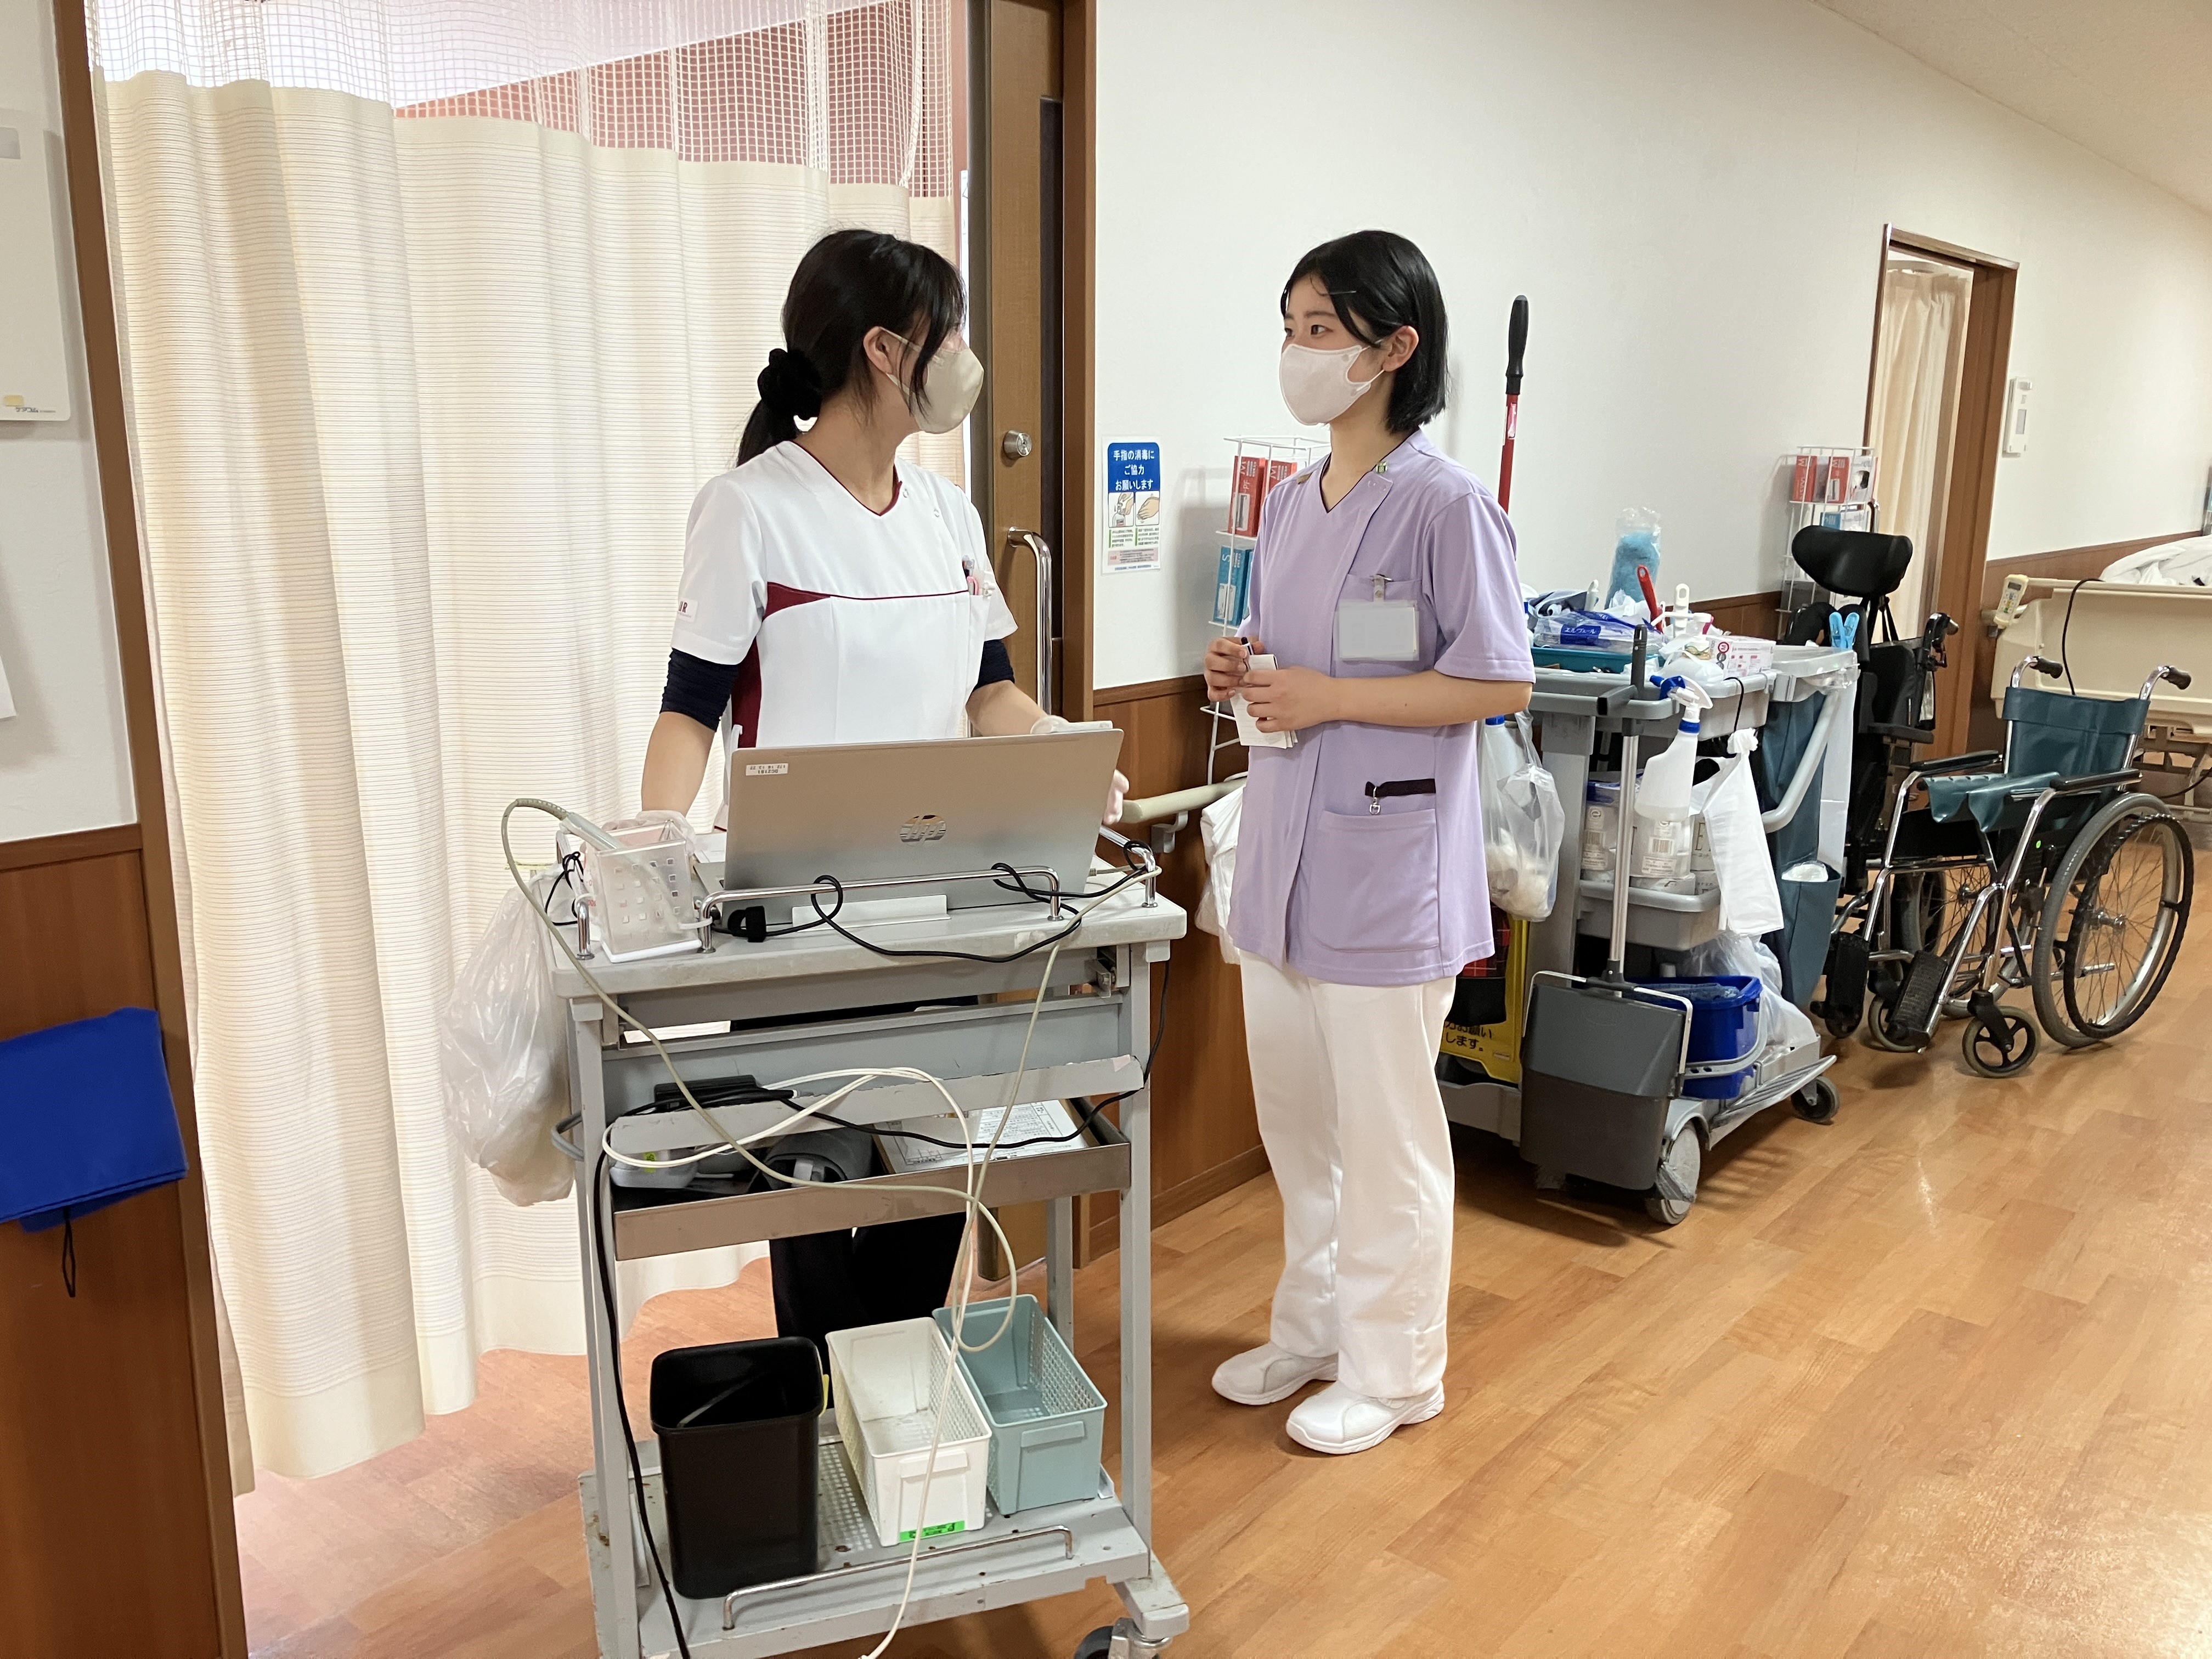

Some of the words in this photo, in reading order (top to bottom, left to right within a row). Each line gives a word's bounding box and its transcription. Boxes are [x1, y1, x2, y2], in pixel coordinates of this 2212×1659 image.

[1113, 449, 1154, 461] 手指の消毒に
[1124, 464, 1144, 476] ご協力
[1115, 478, 1154, 491] お願いします
[904, 815, 943, 846] hp
